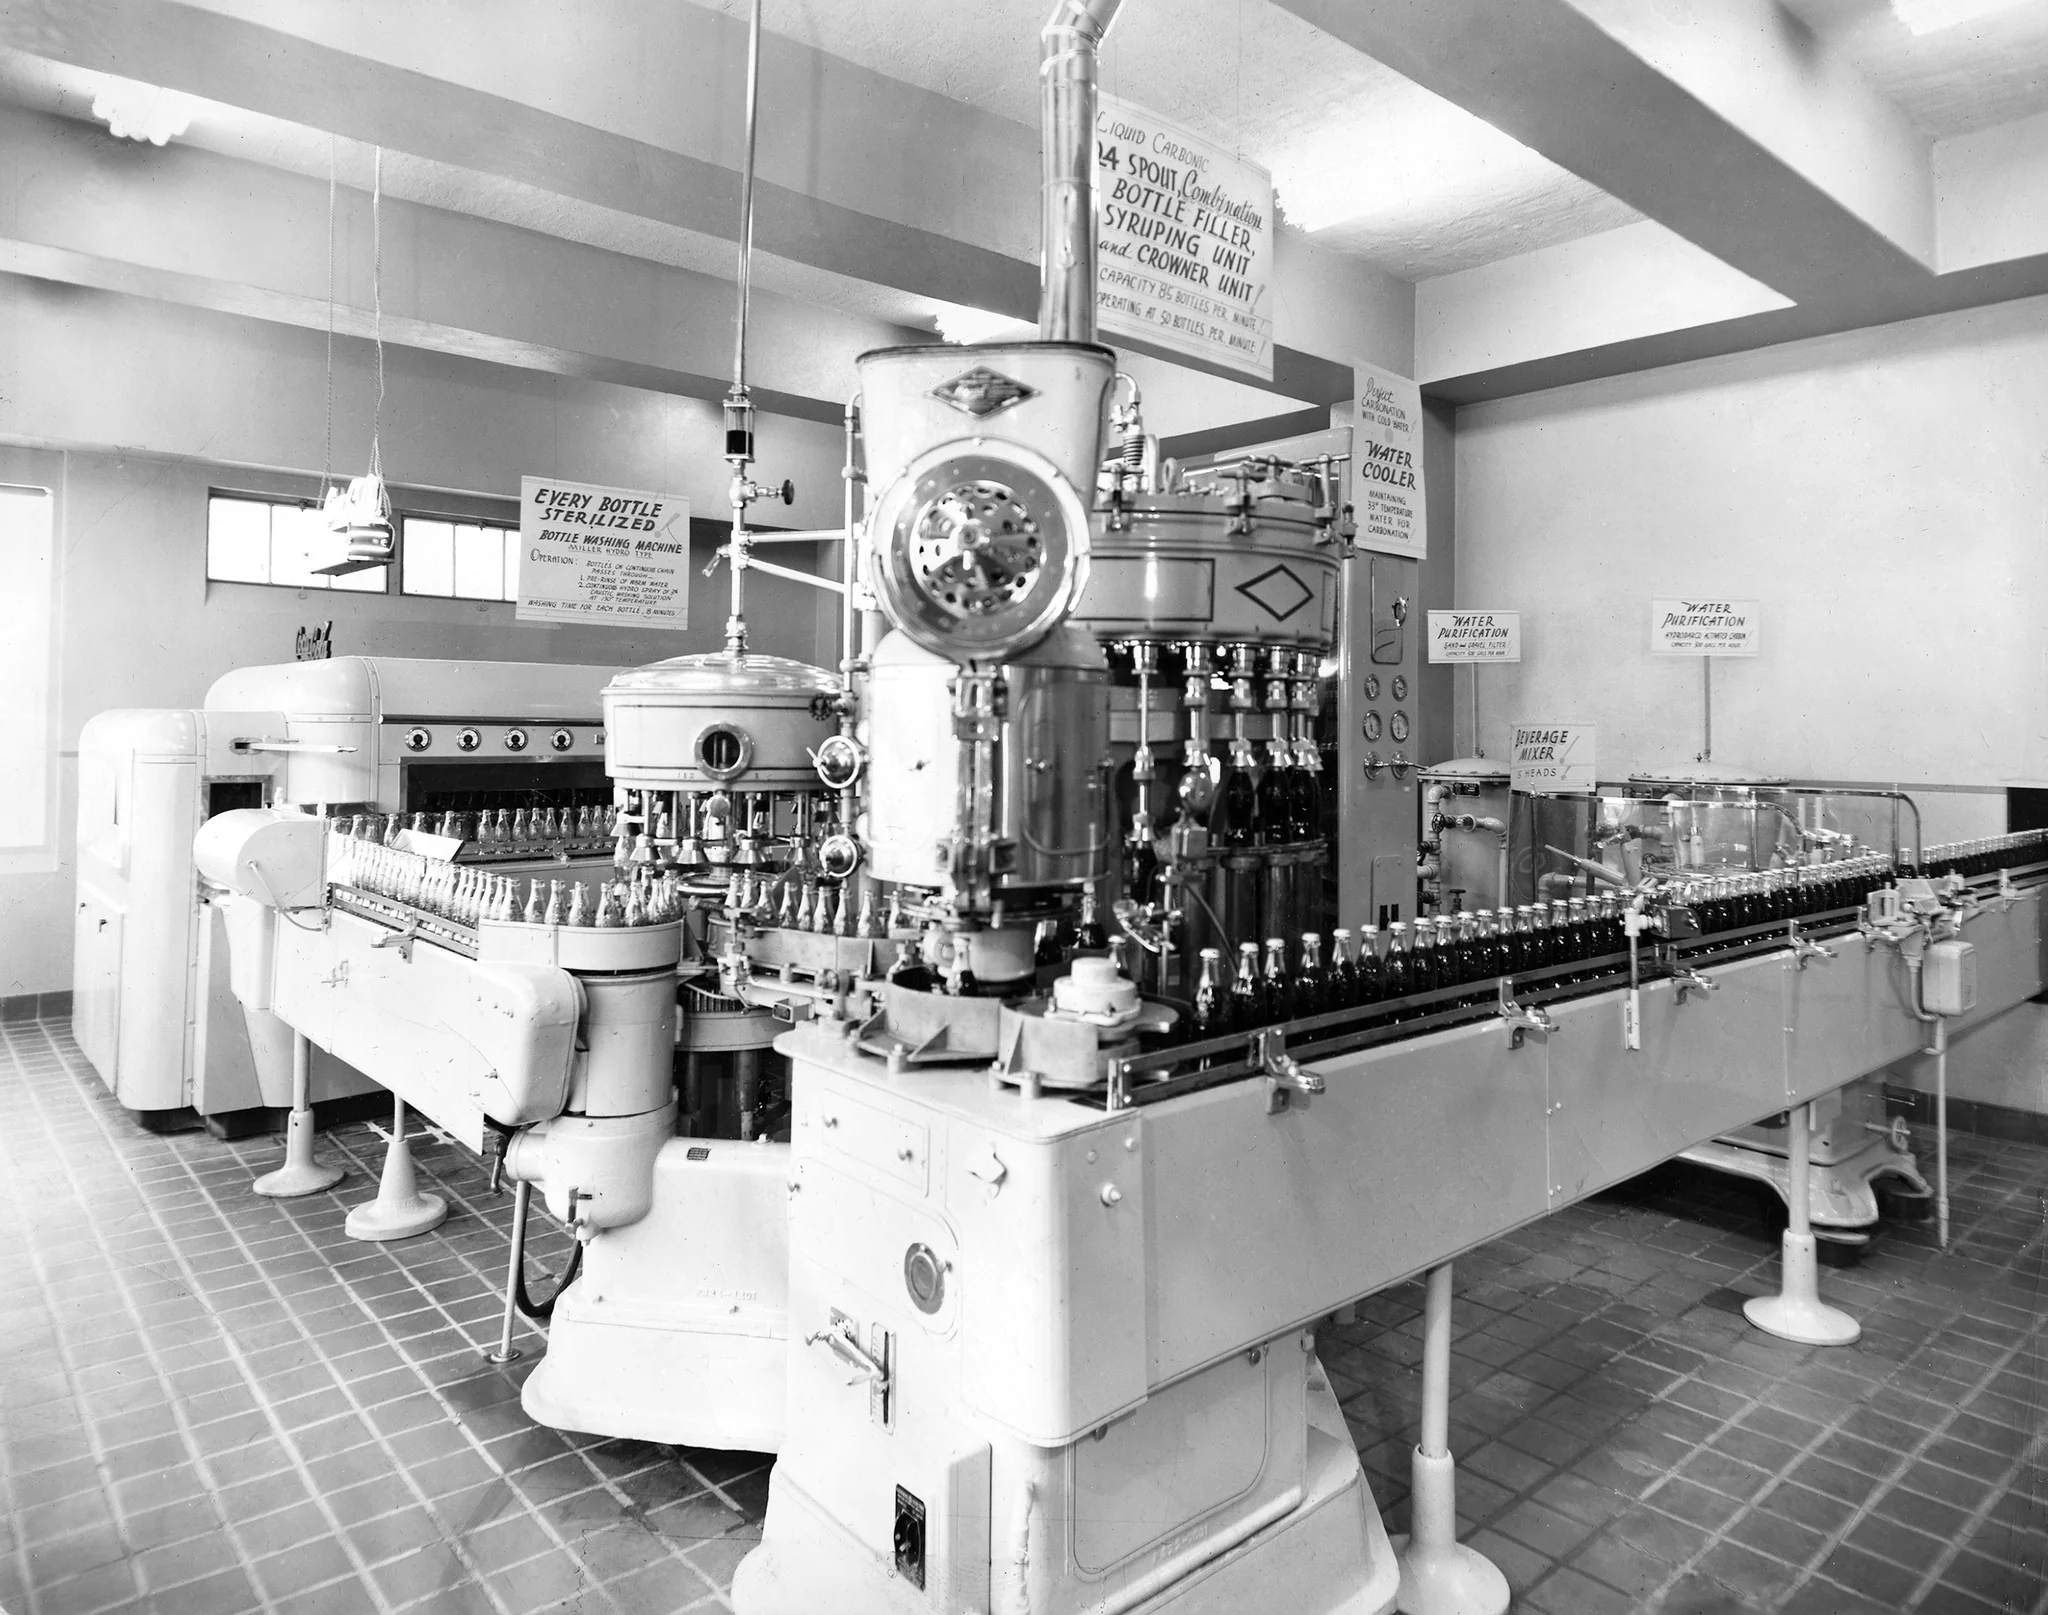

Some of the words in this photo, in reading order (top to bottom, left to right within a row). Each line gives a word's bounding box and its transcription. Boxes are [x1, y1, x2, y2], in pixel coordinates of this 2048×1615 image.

[1153, 132, 1210, 173] CARBONIC
[1112, 177, 1187, 223] BOTTLE
[1104, 203, 1201, 257] SYRUPING
[1212, 245, 1251, 276] UNIT
[1099, 239, 1132, 259] and
[1137, 244, 1209, 287] CROWNER
[1099, 267, 1157, 294] CAPACITY
[1158, 283, 1174, 300] 85
[1175, 290, 1210, 313] BOTTLES
[1145, 306, 1157, 320] AT
[1172, 314, 1205, 336] BOTTLES
[1361, 398, 1406, 421] CARBONATION
[1362, 409, 1375, 423] WITH
[1377, 414, 1391, 428] COLD
[1365, 440, 1413, 469] WATER
[1362, 462, 1417, 490] COOLER
[534, 488, 593, 509] EVERY
[598, 496, 663, 518] BOTTLE
[1368, 490, 1407, 506] MAINTAINING
[1380, 503, 1413, 519] TEMPERATURE
[538, 507, 656, 532] STERILIZED
[1369, 514, 1393, 526] WATER
[1397, 517, 1411, 529] FOR
[1368, 524, 1409, 540] CARBONATION
[539, 529, 580, 544] BOTTLE
[583, 534, 630, 549] WASHING
[635, 540, 683, 554] MACHINE
[568, 544, 602, 554] MILLER
[586, 560, 612, 569] BOTTLES
[625, 564, 656, 573] CONTINUOUS
[656, 567, 675, 575] CHAIN
[591, 568, 616, 576] PASSES
[643, 593, 673, 601] SOLUTION
[527, 599, 557, 608] WASHING
[561, 602, 577, 610] TIME
[580, 603, 592, 611] FOR
[596, 604, 613, 612] EACH
[1681, 601, 1732, 613] WATER
[1452, 615, 1495, 627] WATER
[1660, 612, 1746, 629] PURIFICATION
[1437, 627, 1509, 639] PURIFICATION
[1518, 746, 1555, 761] MIXER
[1525, 768, 1557, 778] HEADS
